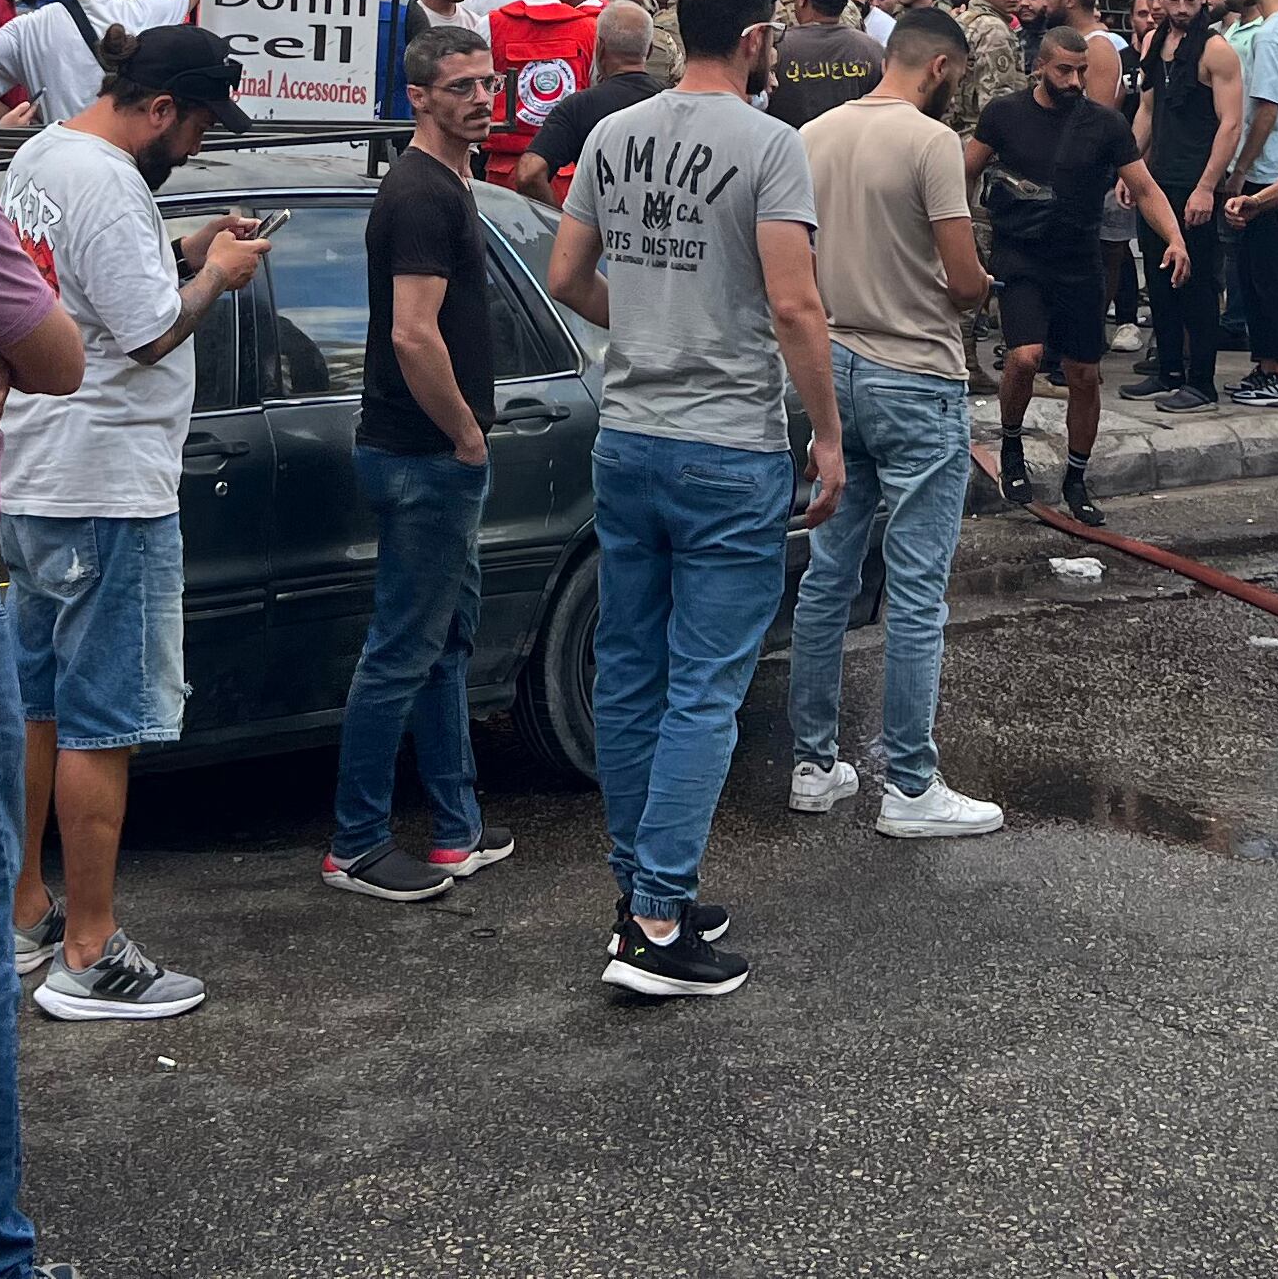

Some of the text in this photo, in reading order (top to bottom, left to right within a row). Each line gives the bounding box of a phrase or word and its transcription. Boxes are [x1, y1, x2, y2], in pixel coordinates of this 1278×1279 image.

[222, 24, 353, 65] cell
[229, 69, 367, 105] ginal Accessories
[596, 135, 739, 206] AMIRI
[605, 229, 708, 261] RTS DISRICT
